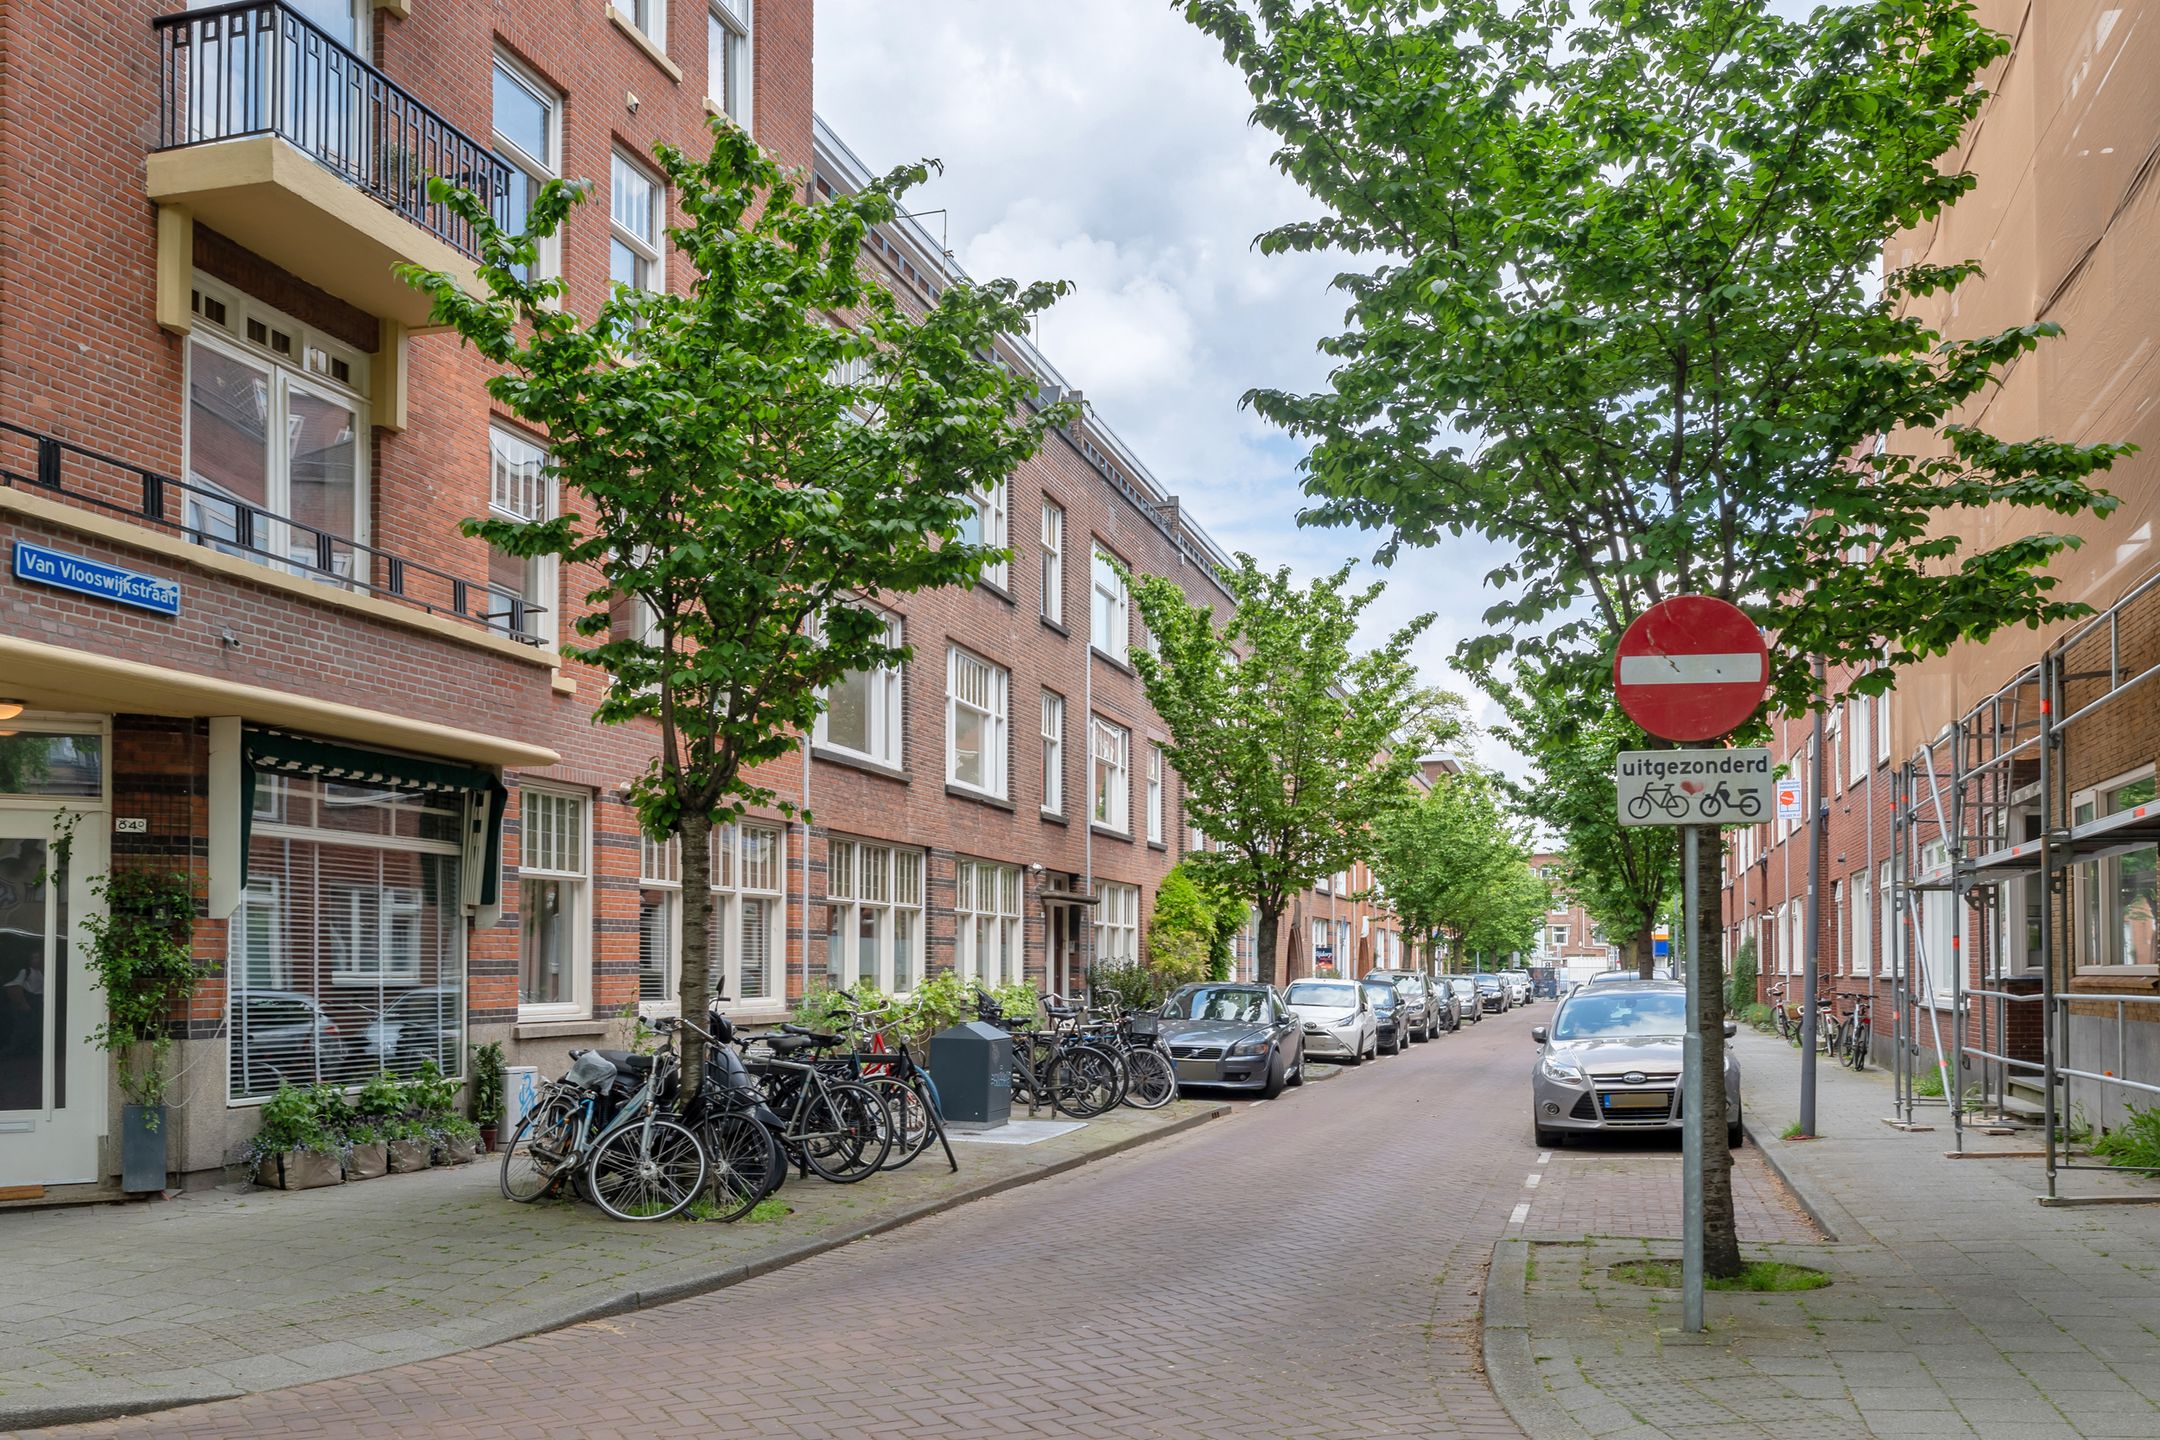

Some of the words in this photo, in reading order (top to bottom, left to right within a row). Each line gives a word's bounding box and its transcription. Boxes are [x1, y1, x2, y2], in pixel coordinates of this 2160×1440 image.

[24, 551, 55, 576] Van
[60, 560, 175, 605] Vlooswijkstraat
[1622, 755, 1768, 780] uitgezonderd
